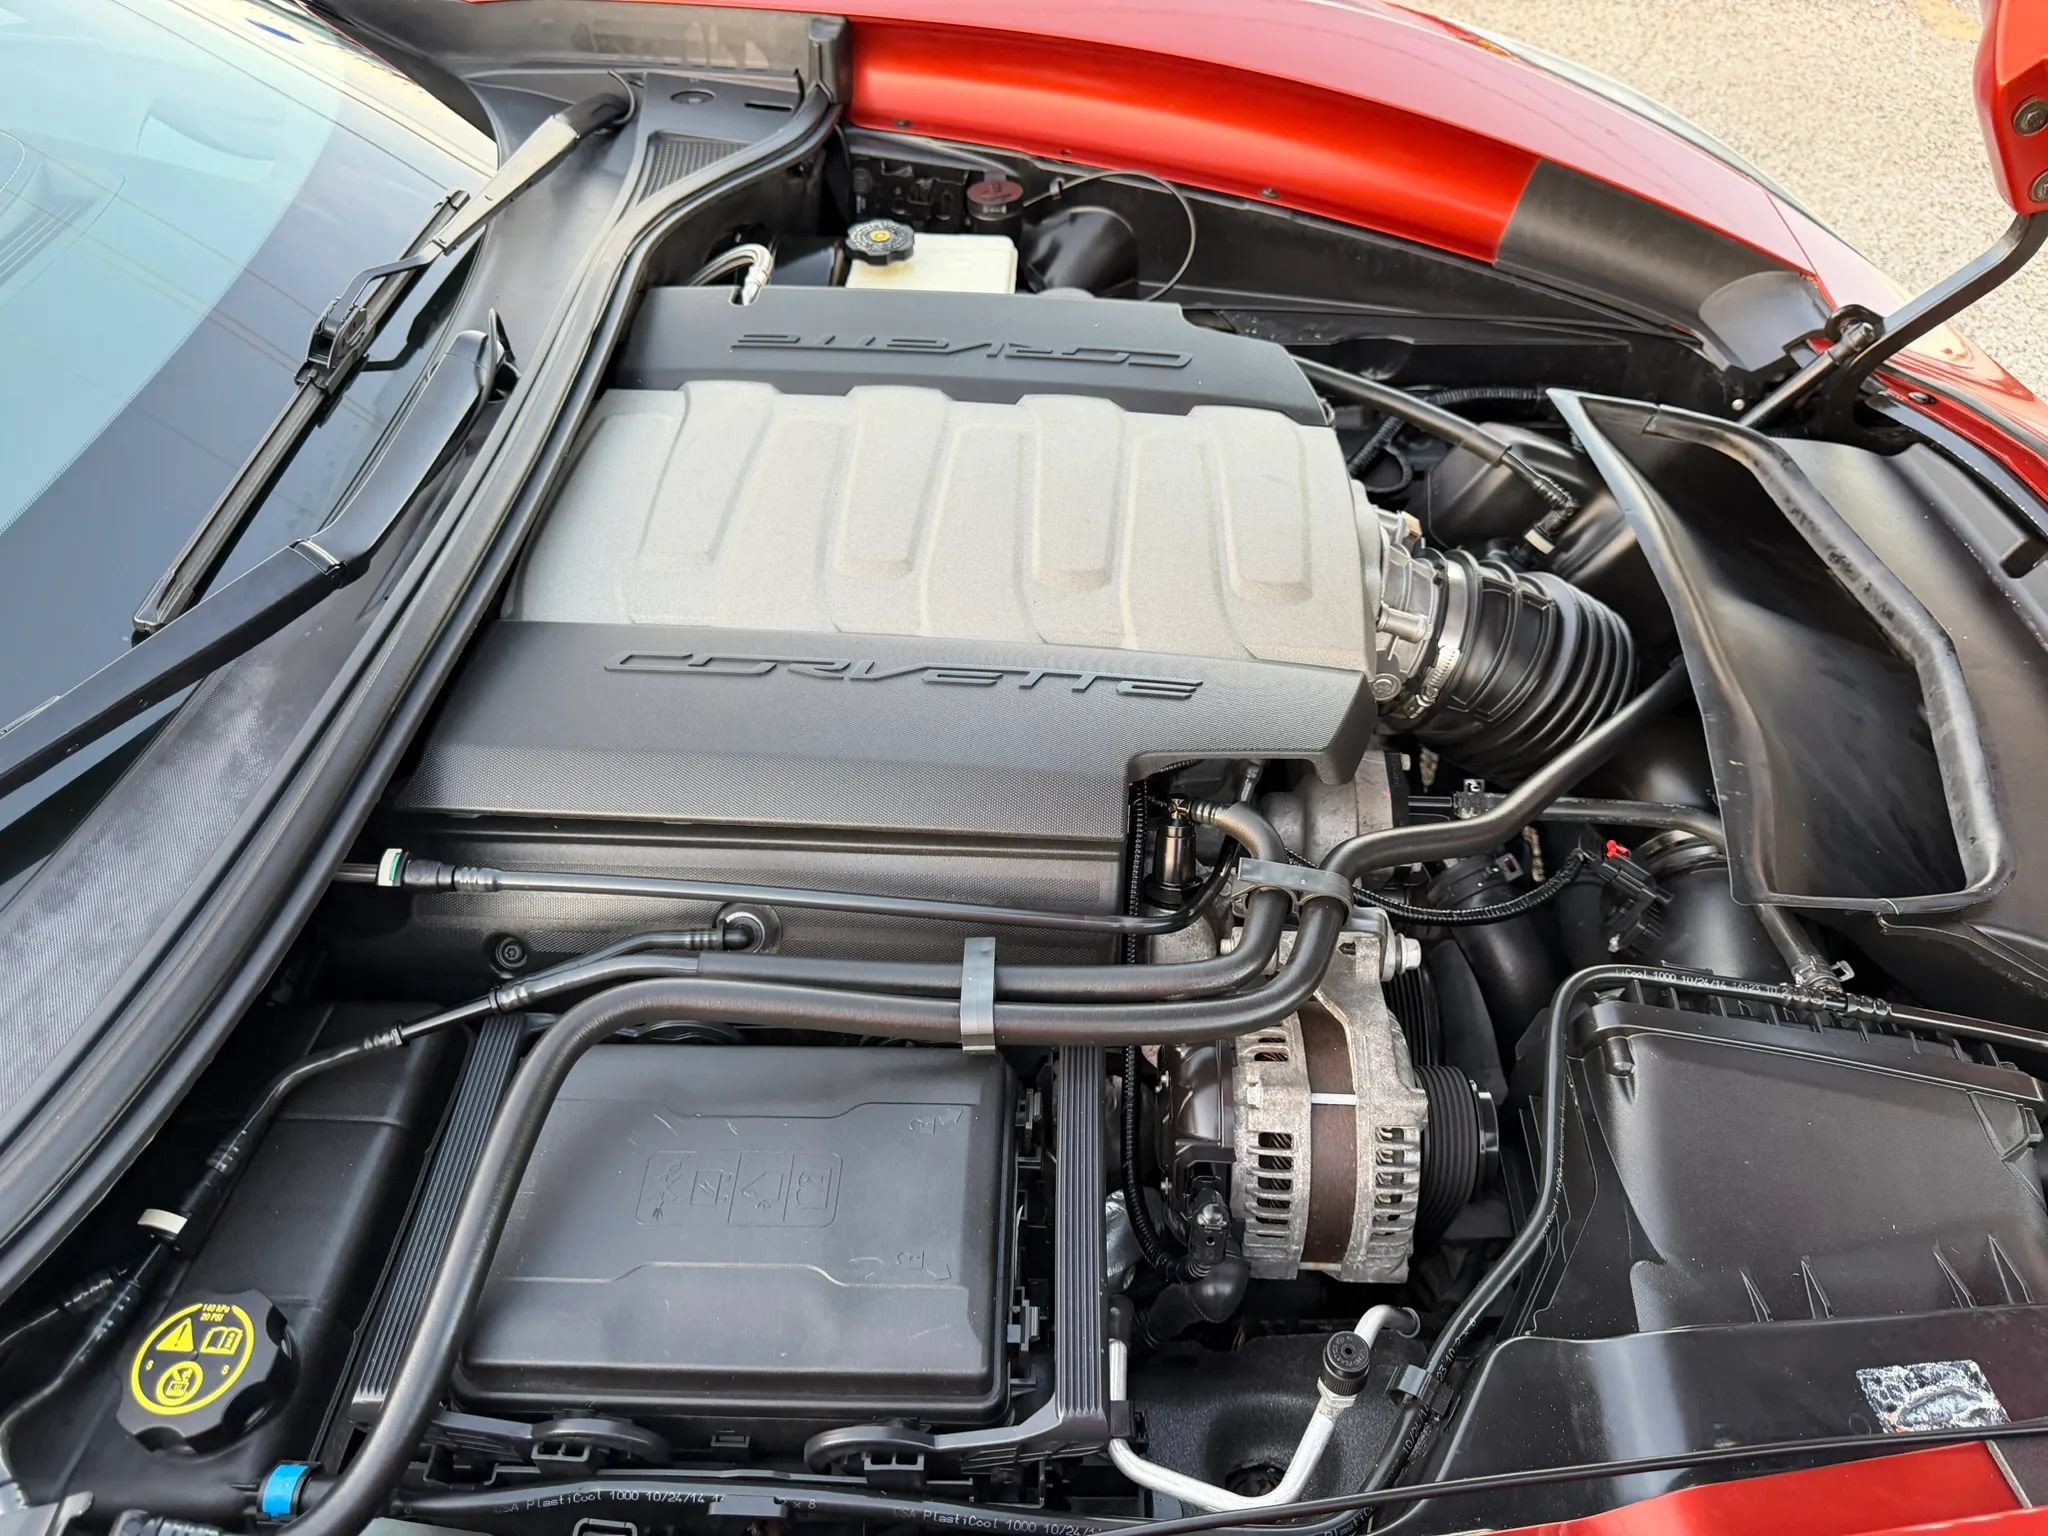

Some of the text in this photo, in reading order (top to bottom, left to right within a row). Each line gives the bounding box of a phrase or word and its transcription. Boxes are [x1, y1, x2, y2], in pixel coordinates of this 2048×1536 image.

[731, 333, 1193, 368] CORVETTE
[604, 651, 1205, 700] CORVETTE
[1653, 971, 1677, 983] 1000
[200, 1313, 224, 1322] 20 PSI
[526, 1489, 603, 1510] PlastiCool
[609, 1490, 639, 1502] 1000
[646, 1491, 705, 1504] 10/24/14
[923, 1509, 998, 1530] PlastiCool
[1006, 1518, 1037, 1533] 1000
